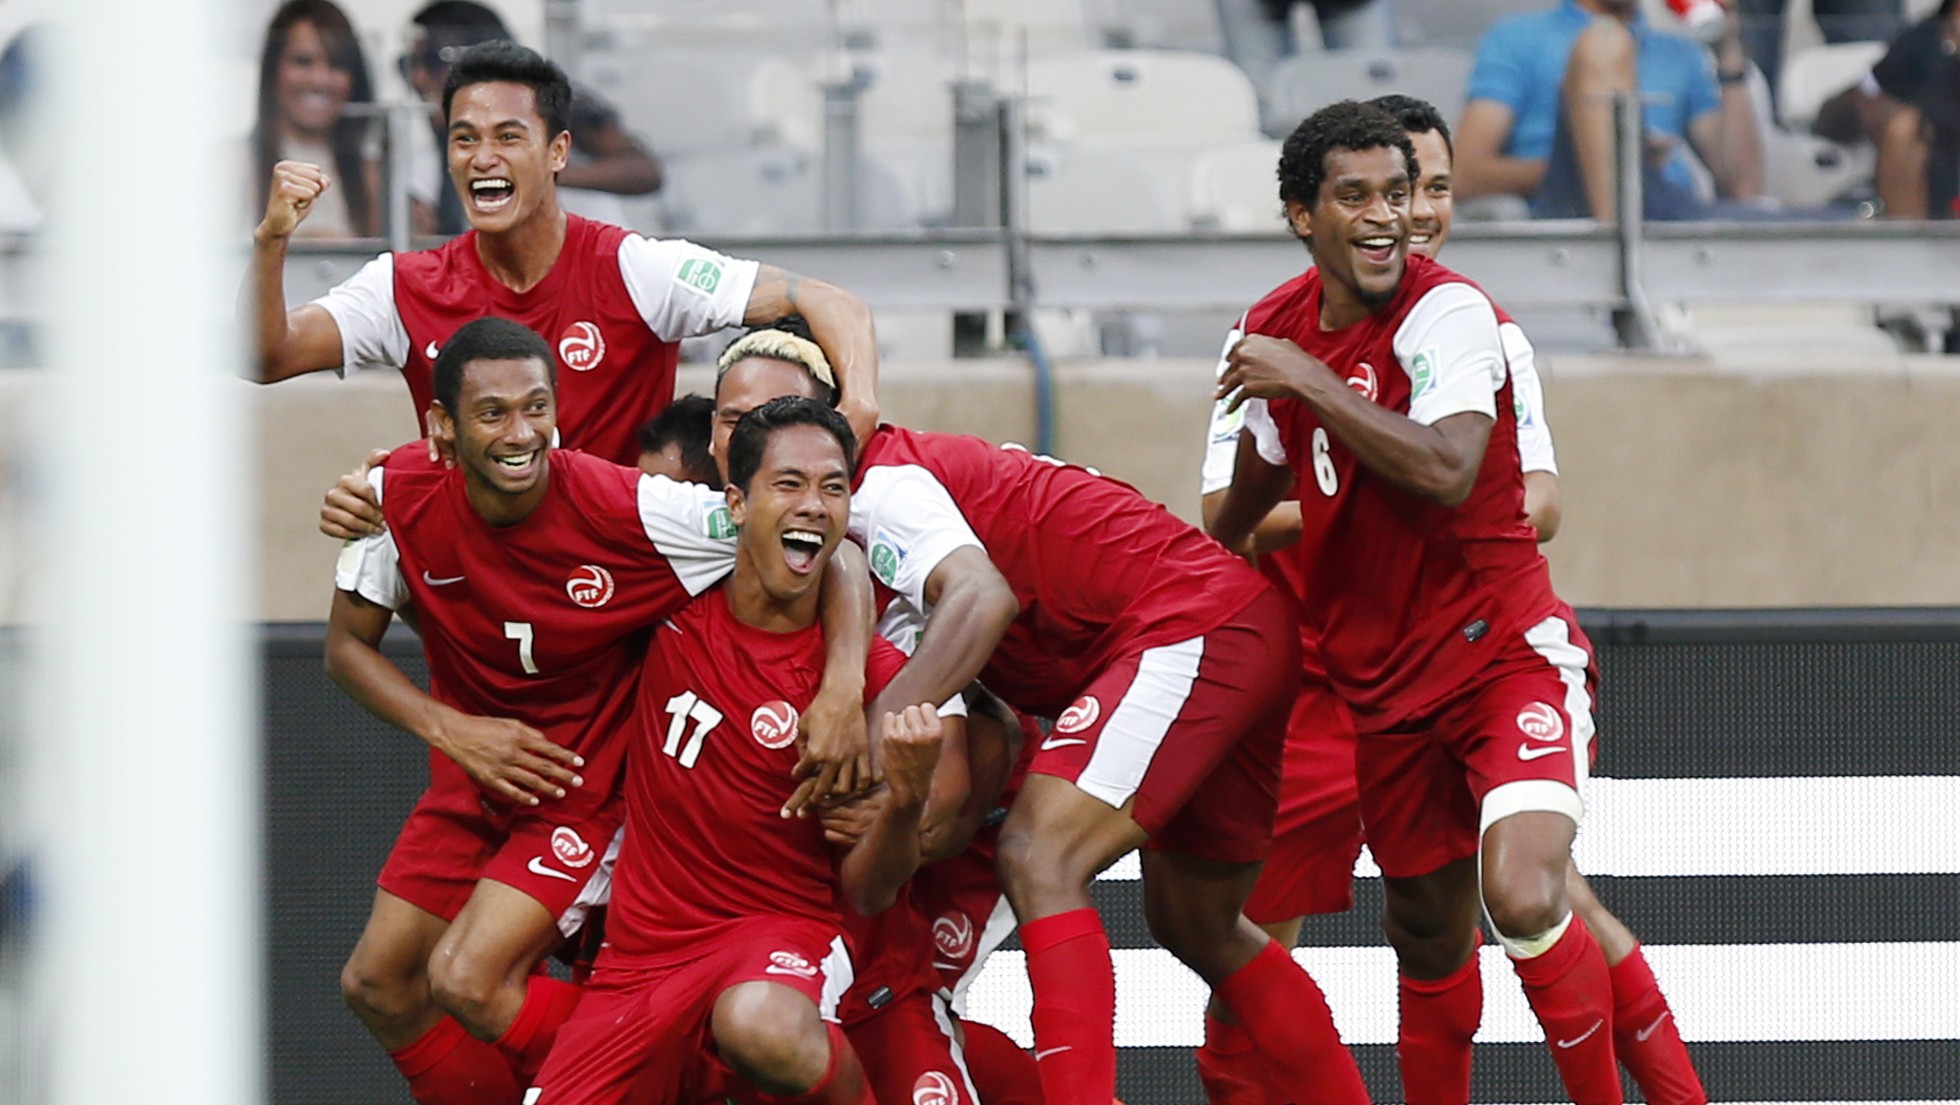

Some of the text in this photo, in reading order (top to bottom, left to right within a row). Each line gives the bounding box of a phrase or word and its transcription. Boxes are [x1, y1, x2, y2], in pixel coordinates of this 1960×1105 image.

[567, 349, 590, 364] FTF
[1312, 427, 1338, 496] 6
[575, 588, 599, 602] FTF
[504, 621, 539, 674] 7
[662, 690, 724, 769] 17
[753, 720, 779, 739] FTF
[553, 837, 578, 856] FTF
